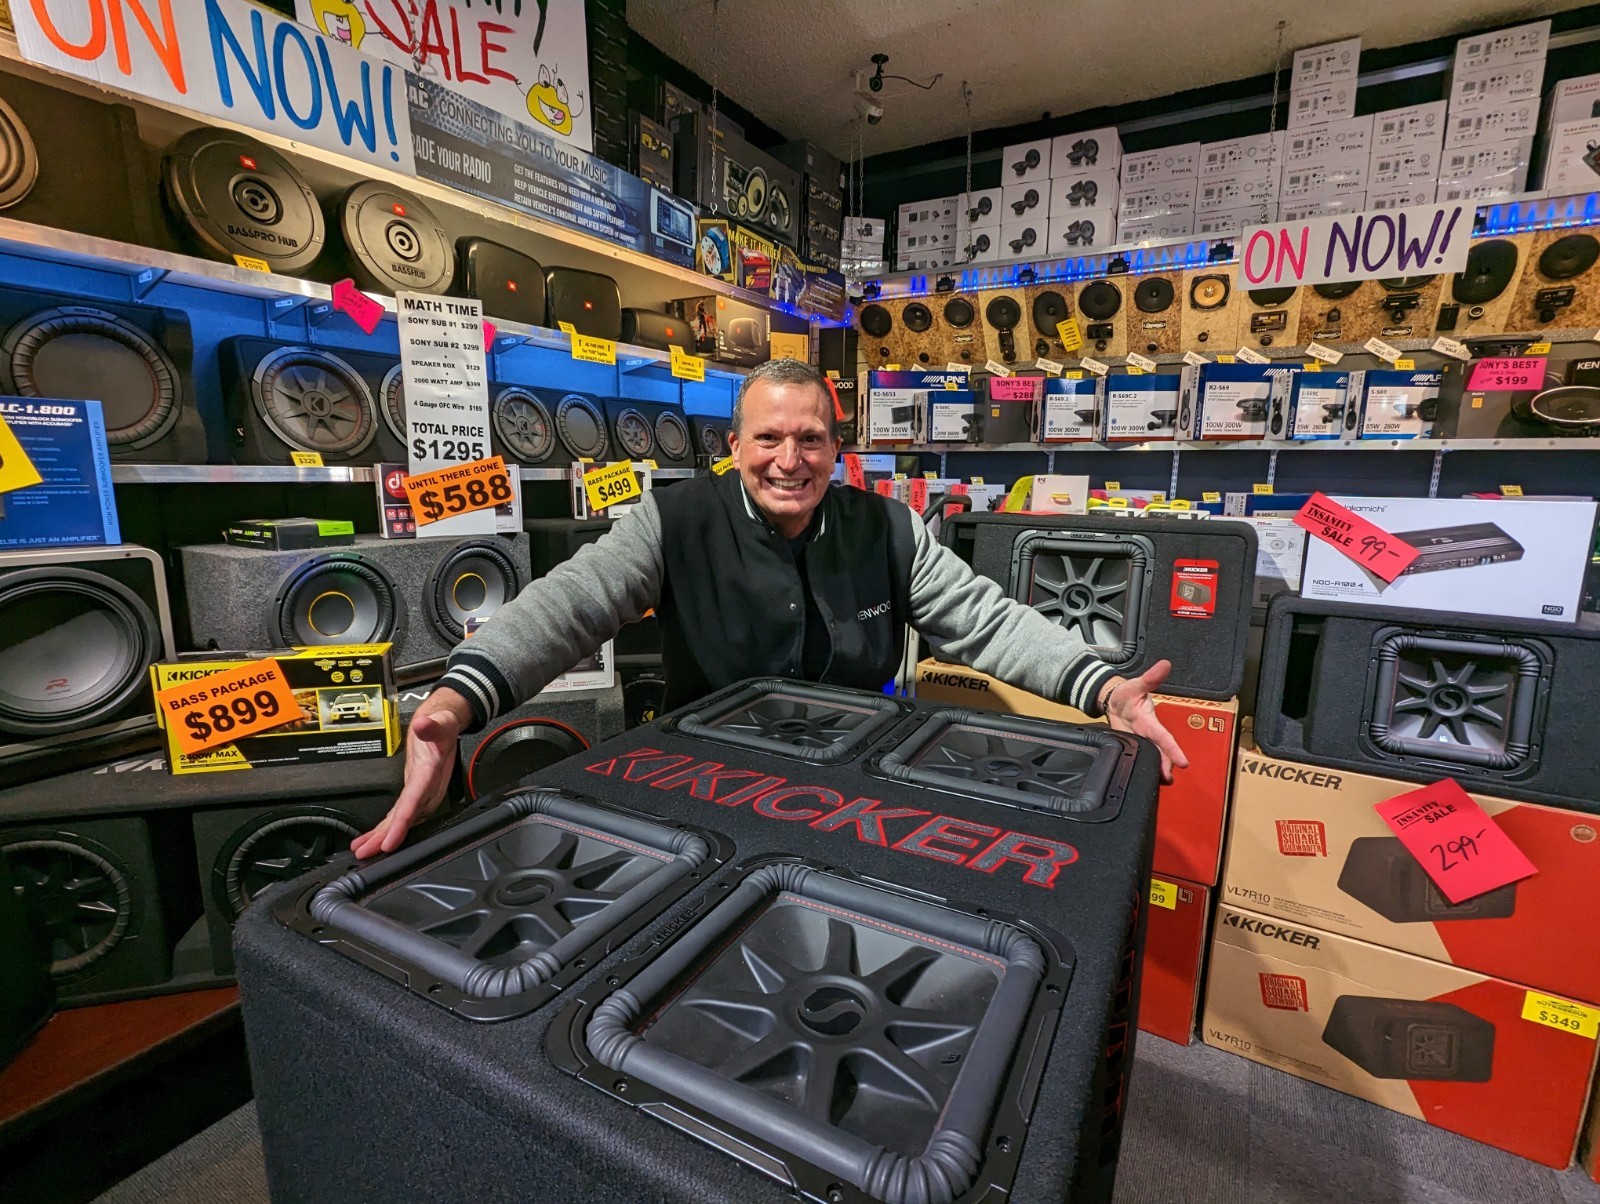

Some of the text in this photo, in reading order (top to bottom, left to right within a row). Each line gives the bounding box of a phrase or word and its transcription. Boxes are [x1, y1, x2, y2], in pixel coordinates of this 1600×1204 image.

[30, 0, 187, 95] ON
[205, 0, 401, 163] NOW!
[440, 99, 608, 185] CONNECTING YOU TO YOUR MUSIC
[437, 145, 461, 173] YOUR
[463, 152, 492, 184] RADIO
[514, 163, 524, 176] GET
[524, 167, 534, 180] THE
[534, 171, 558, 188] FEATURES
[557, 180, 568, 193] YOU
[567, 184, 580, 198] NEED
[514, 178, 527, 191] KEEP
[528, 183, 548, 199] VEHICLE
[548, 189, 583, 212] ENTERTAINMENT
[514, 193, 532, 207] RETAIN
[532, 198, 556, 216] VEHICLE'S
[228, 225, 298, 248] BASSPRO HUB
[728, 228, 748, 249] MAKE
[1244, 206, 1463, 284] ON NOW!
[392, 264, 426, 280] BASSHUB
[404, 298, 479, 317] MATH TIME
[407, 316, 478, 331] SONY SUB #1 $299
[410, 338, 480, 351] SONY SUB #2 $299
[411, 360, 441, 368] SPEAKER
[1479, 360, 1540, 370] SONY'S BEST
[429, 377, 448, 386] WATT
[930, 375, 966, 384] ALPINE
[1495, 376, 1529, 386] $199
[419, 400, 438, 410] Gauge
[451, 402, 465, 411] Wire
[412, 422, 484, 437] TOTAL PRICE
[1205, 421, 1243, 429] 100W 300W
[94, 421, 104, 453] AMPLIFIER
[412, 438, 485, 462] $1295
[99, 452, 108, 489] SUBWOOFER
[408, 461, 500, 491] UNTIL THERE GONE
[587, 466, 631, 487] BASS PACKAGE
[104, 490, 112, 508] POWER
[418, 473, 512, 522] $588
[598, 477, 632, 504] $499
[106, 508, 114, 526] HIGH
[1305, 505, 1354, 531] INSANITY
[1320, 526, 1354, 547] SALE
[169, 670, 277, 711] BASS PACKAGE
[933, 674, 991, 693] KICKER
[184, 690, 280, 743] $899
[180, 750, 238, 761] 2400W MAX
[1259, 763, 1343, 791] KICKER
[1396, 800, 1440, 828] INSANITY
[1424, 803, 1457, 825] SALE
[650, 762, 1081, 890] KICKER
[1281, 823, 1318, 834] ORIGINAL
[1283, 833, 1320, 845] SQUARE
[1284, 844, 1322, 853] SUBWOOFER
[1227, 884, 1271, 904] VL7R10
[661, 908, 697, 940] KICKER
[1238, 917, 1321, 951] KICKER
[1265, 976, 1300, 989] ORIGINAL
[1266, 987, 1303, 1000] SQUARE
[1267, 996, 1304, 1008] SUBWOOFER
[1539, 1011, 1581, 1030] $349
[1209, 1028, 1252, 1050] VL7R10
